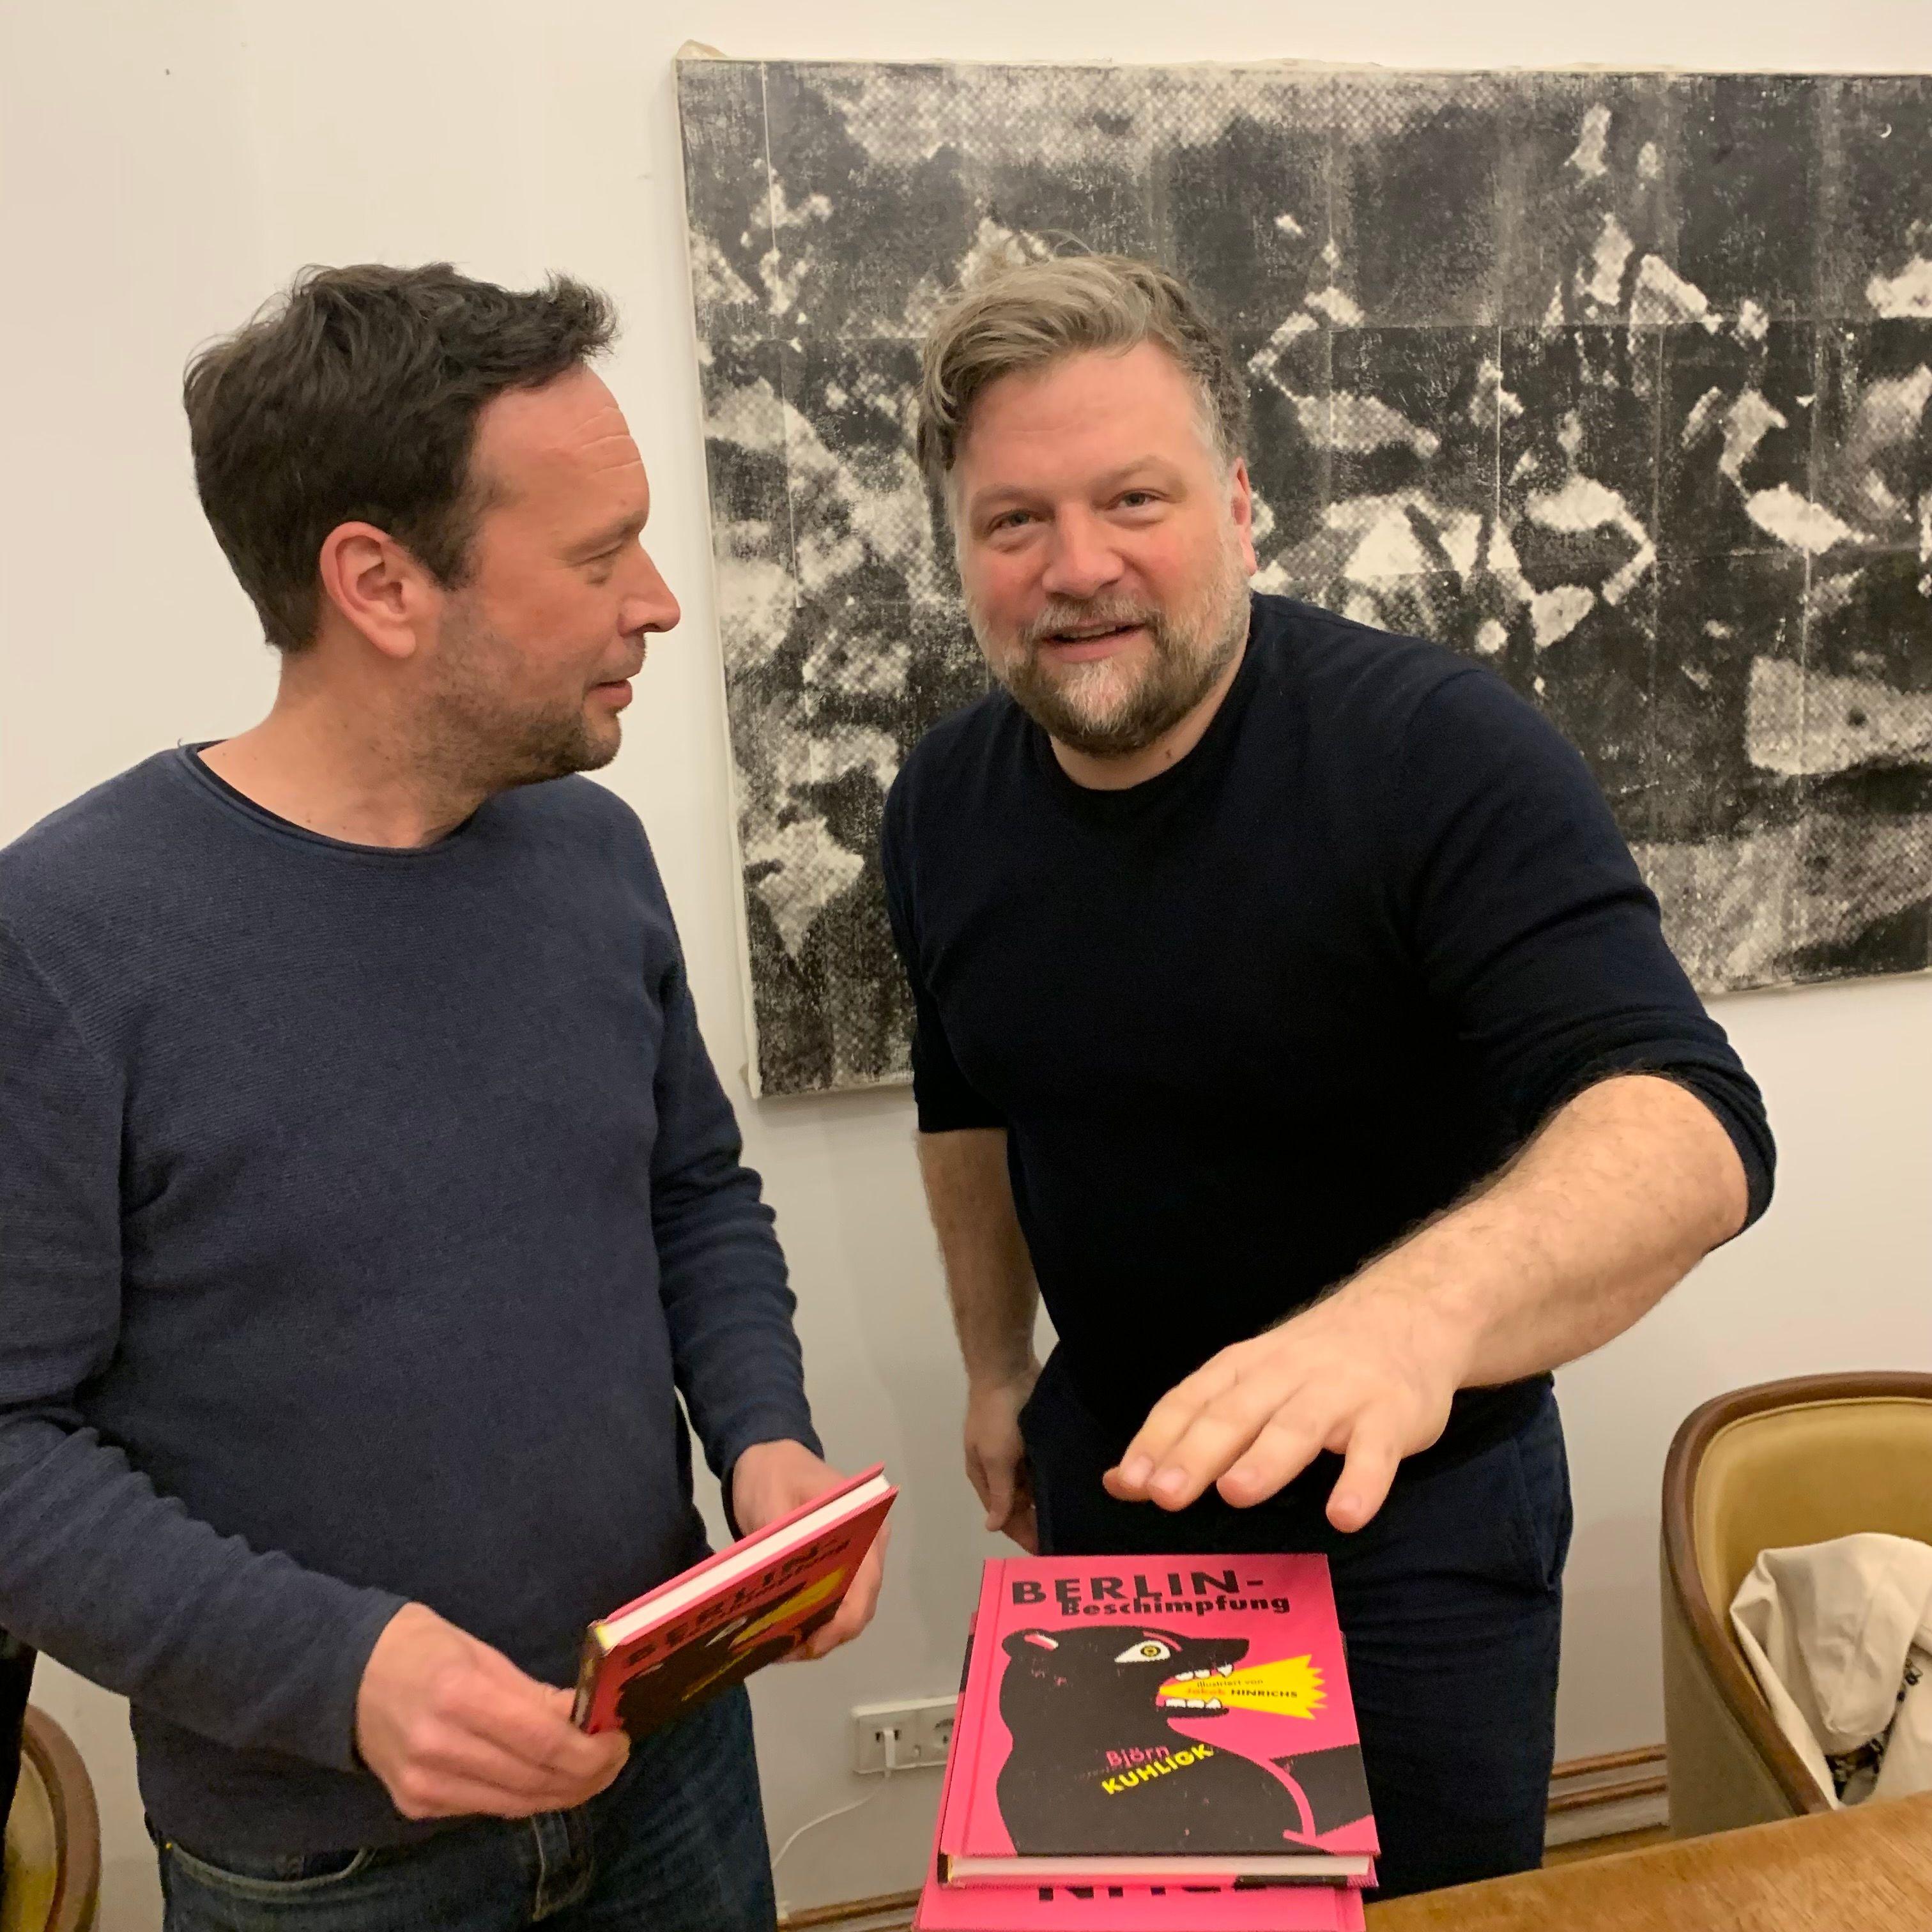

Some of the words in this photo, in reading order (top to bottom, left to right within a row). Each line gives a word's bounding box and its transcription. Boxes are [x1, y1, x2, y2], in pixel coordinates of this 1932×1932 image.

[1012, 1570, 1264, 1605] BERLIN-
[1061, 1595, 1290, 1616] Beschimpfung
[1231, 1689, 1298, 1698] HINRICHS
[1105, 1745, 1170, 1768] Björn
